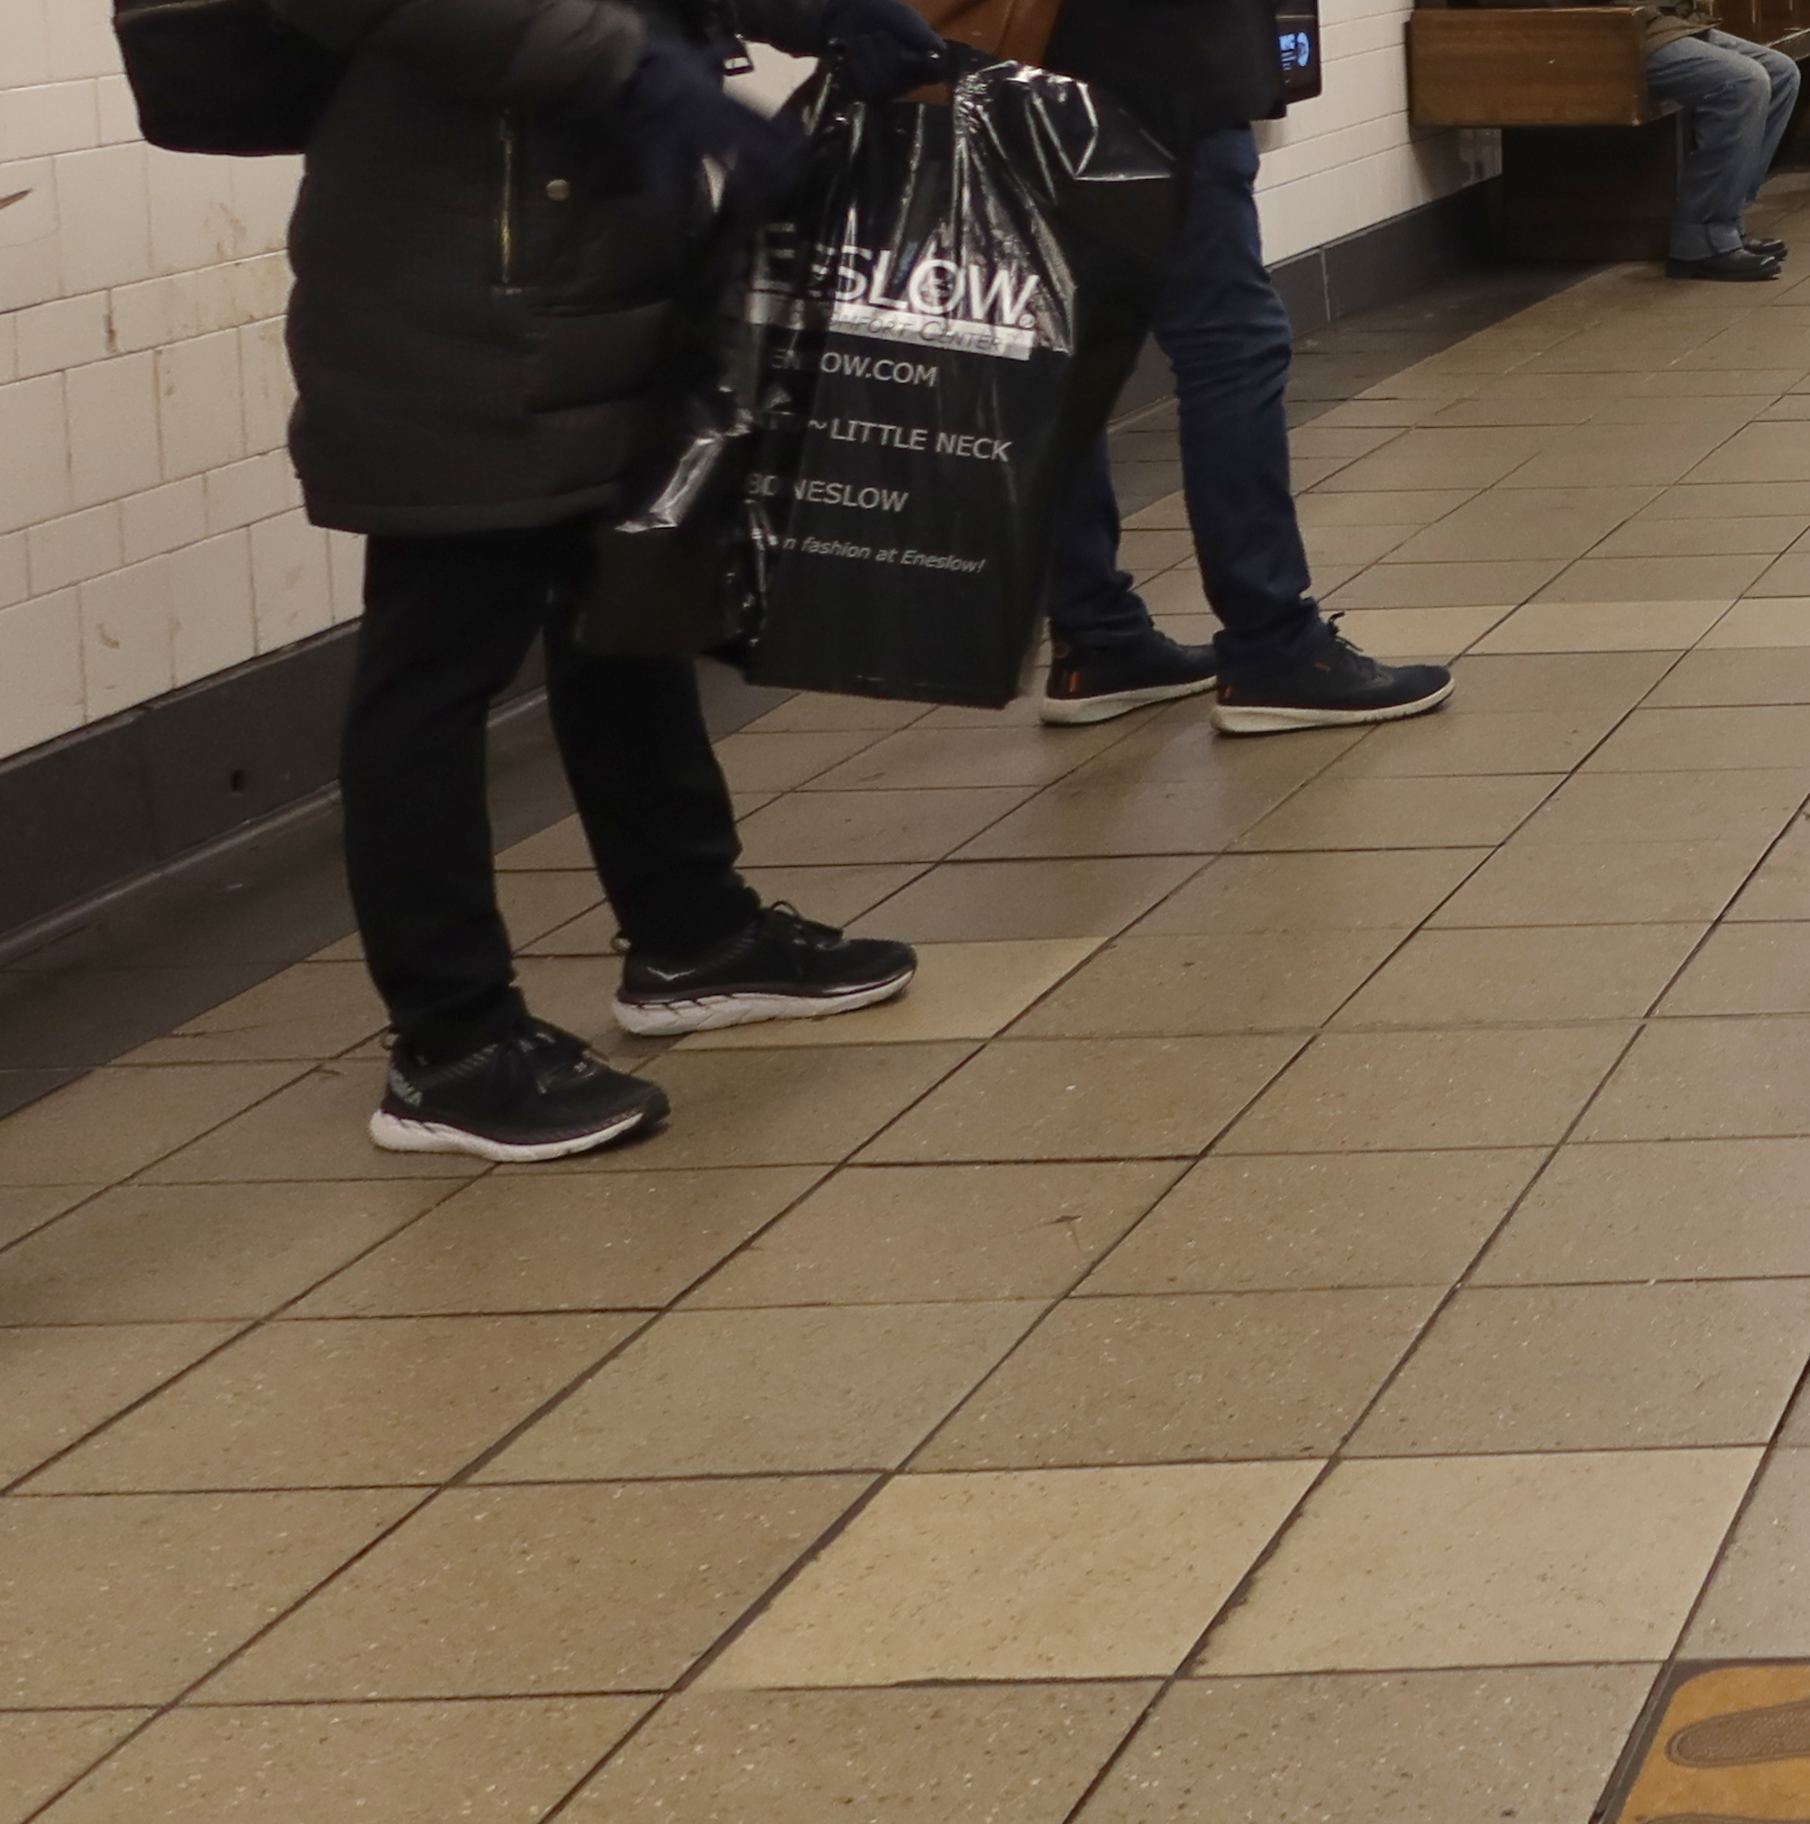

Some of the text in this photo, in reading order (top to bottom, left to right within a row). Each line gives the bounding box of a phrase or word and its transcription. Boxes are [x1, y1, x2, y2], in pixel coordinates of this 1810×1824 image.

[935, 431, 1014, 463] NECK
[801, 535, 870, 562] fashion
[875, 547, 895, 564] at
[900, 549, 987, 575] Eneslow!
